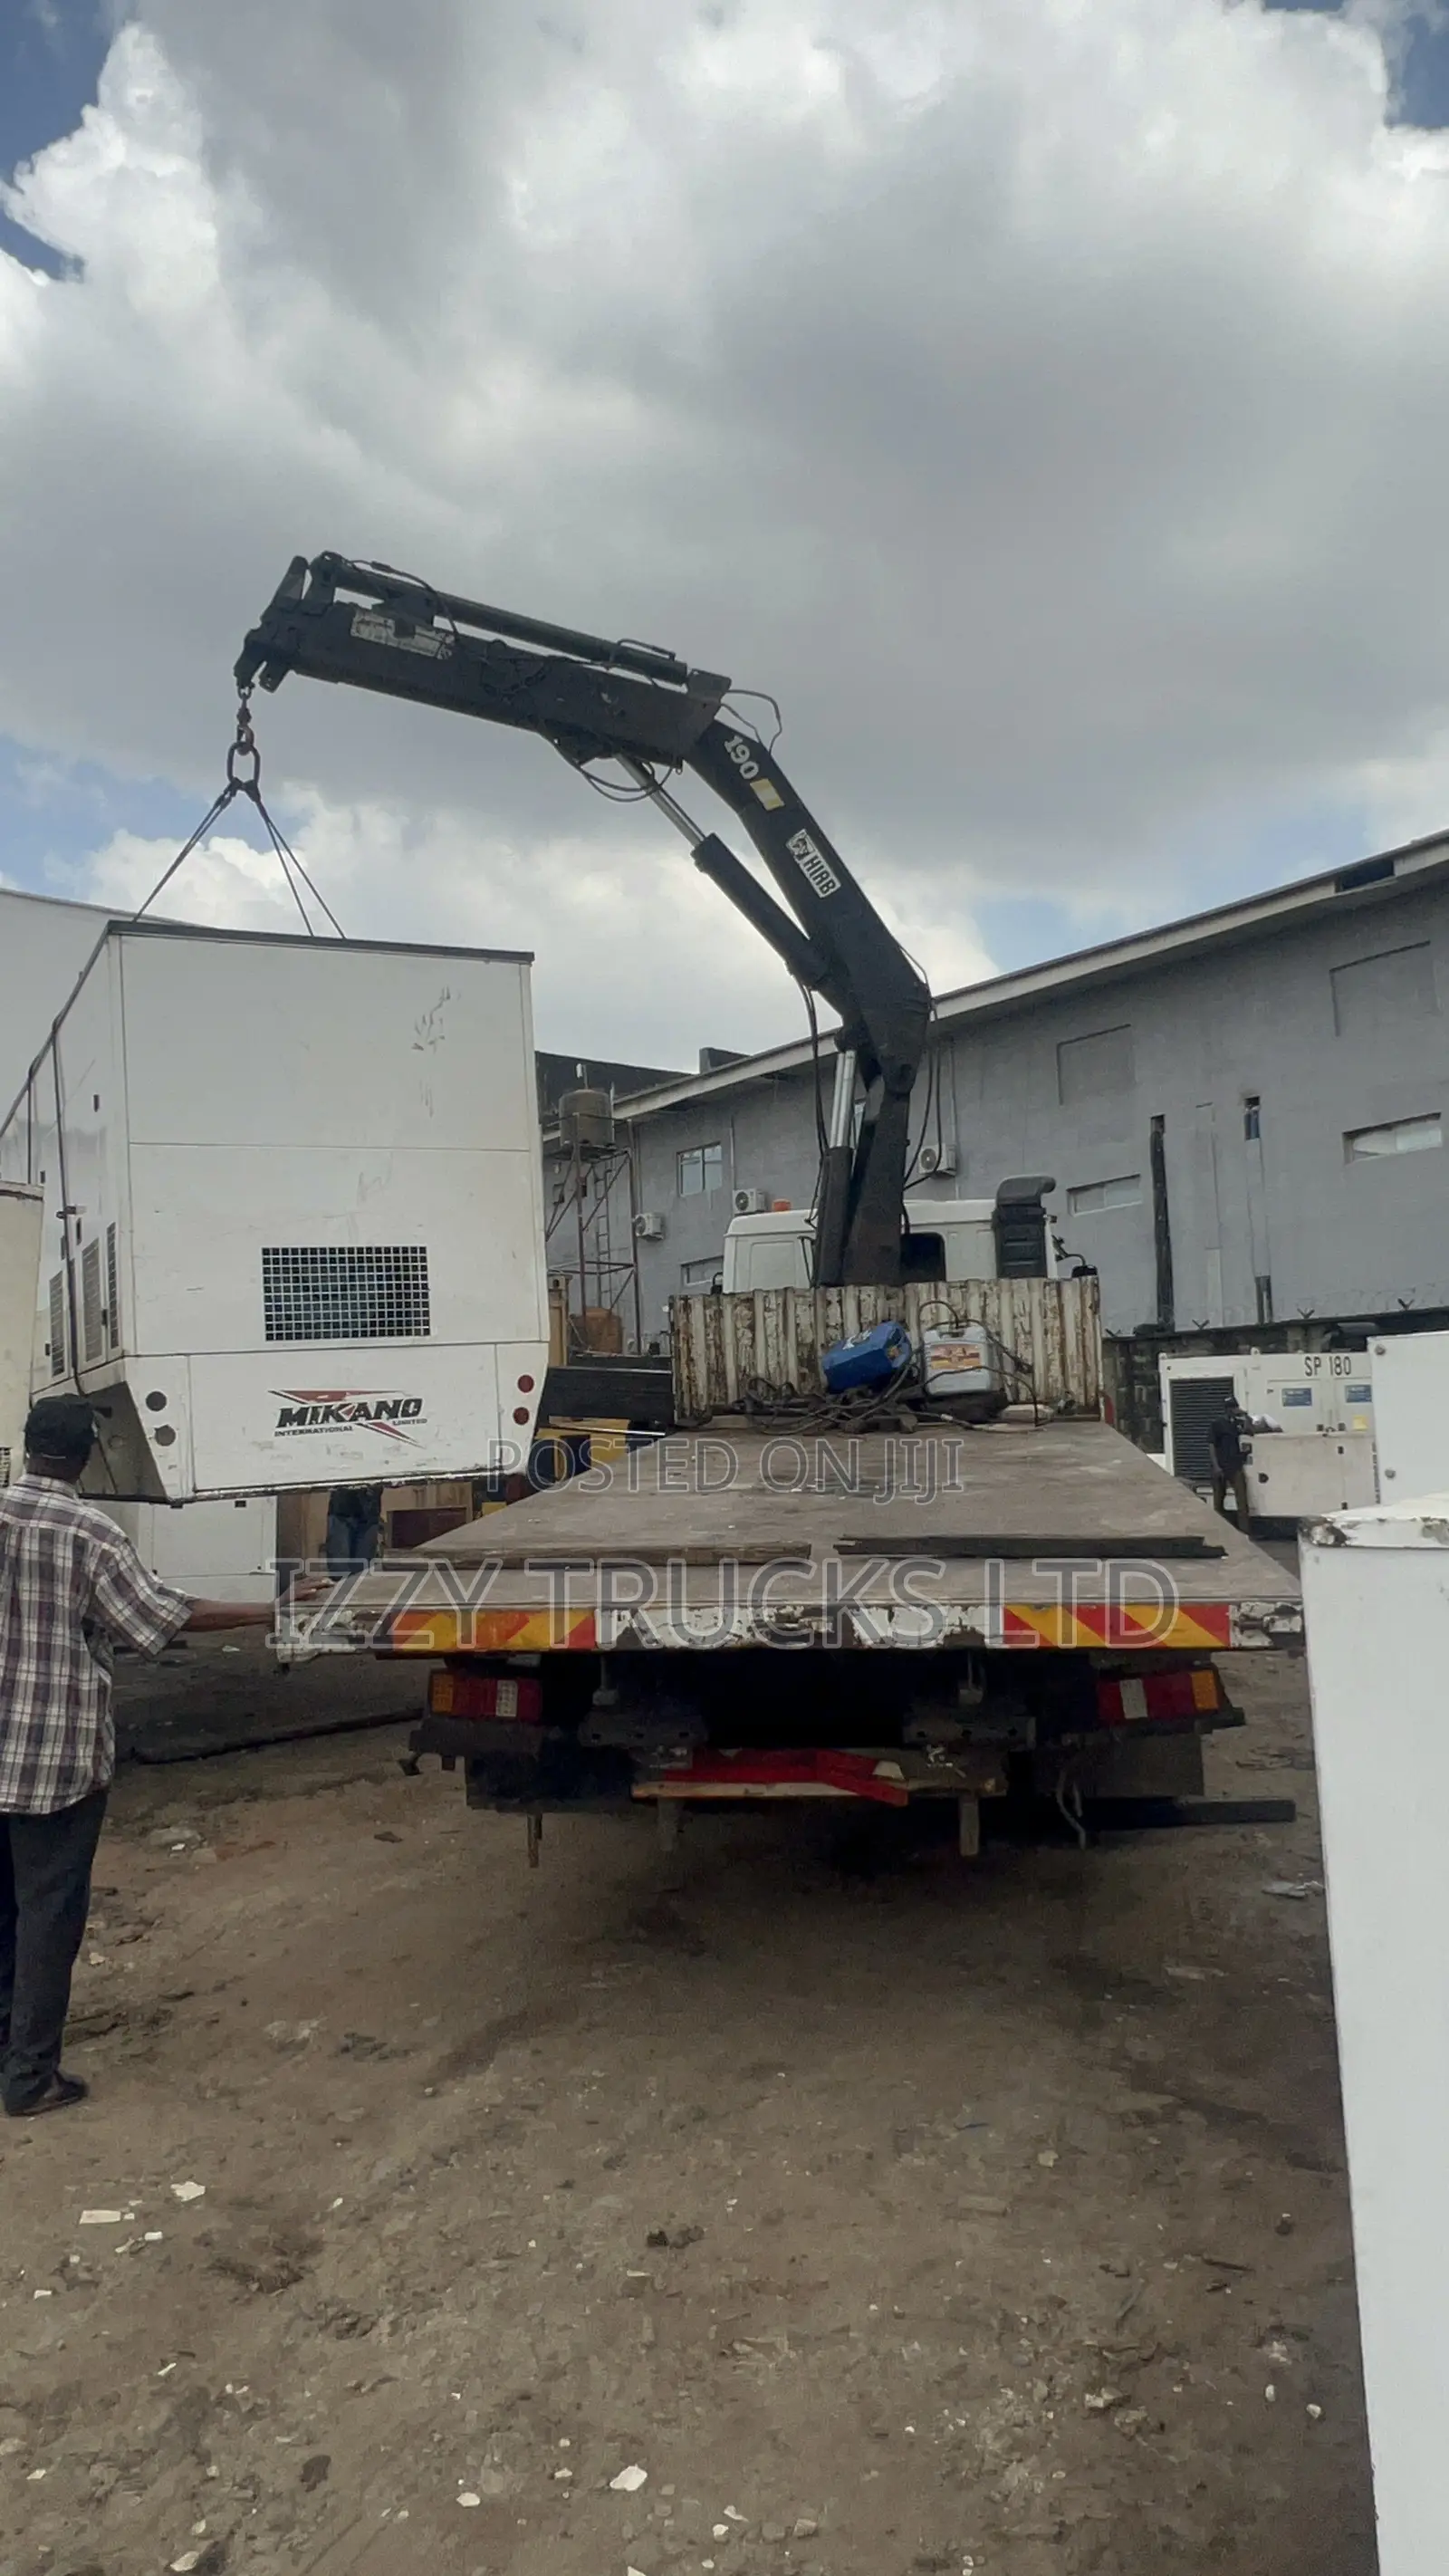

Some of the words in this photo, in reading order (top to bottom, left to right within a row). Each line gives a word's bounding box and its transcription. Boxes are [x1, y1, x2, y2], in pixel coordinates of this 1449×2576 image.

[724, 735, 759, 780] 190
[802, 855, 837, 898] HIAB
[1304, 1356, 1322, 1377] SP
[1328, 1356, 1352, 1376] 180
[273, 1425, 354, 1437] INTERNATIONAL
[392, 1418, 428, 1426] LIMITED
[275, 1398, 423, 1428] MIKANO
